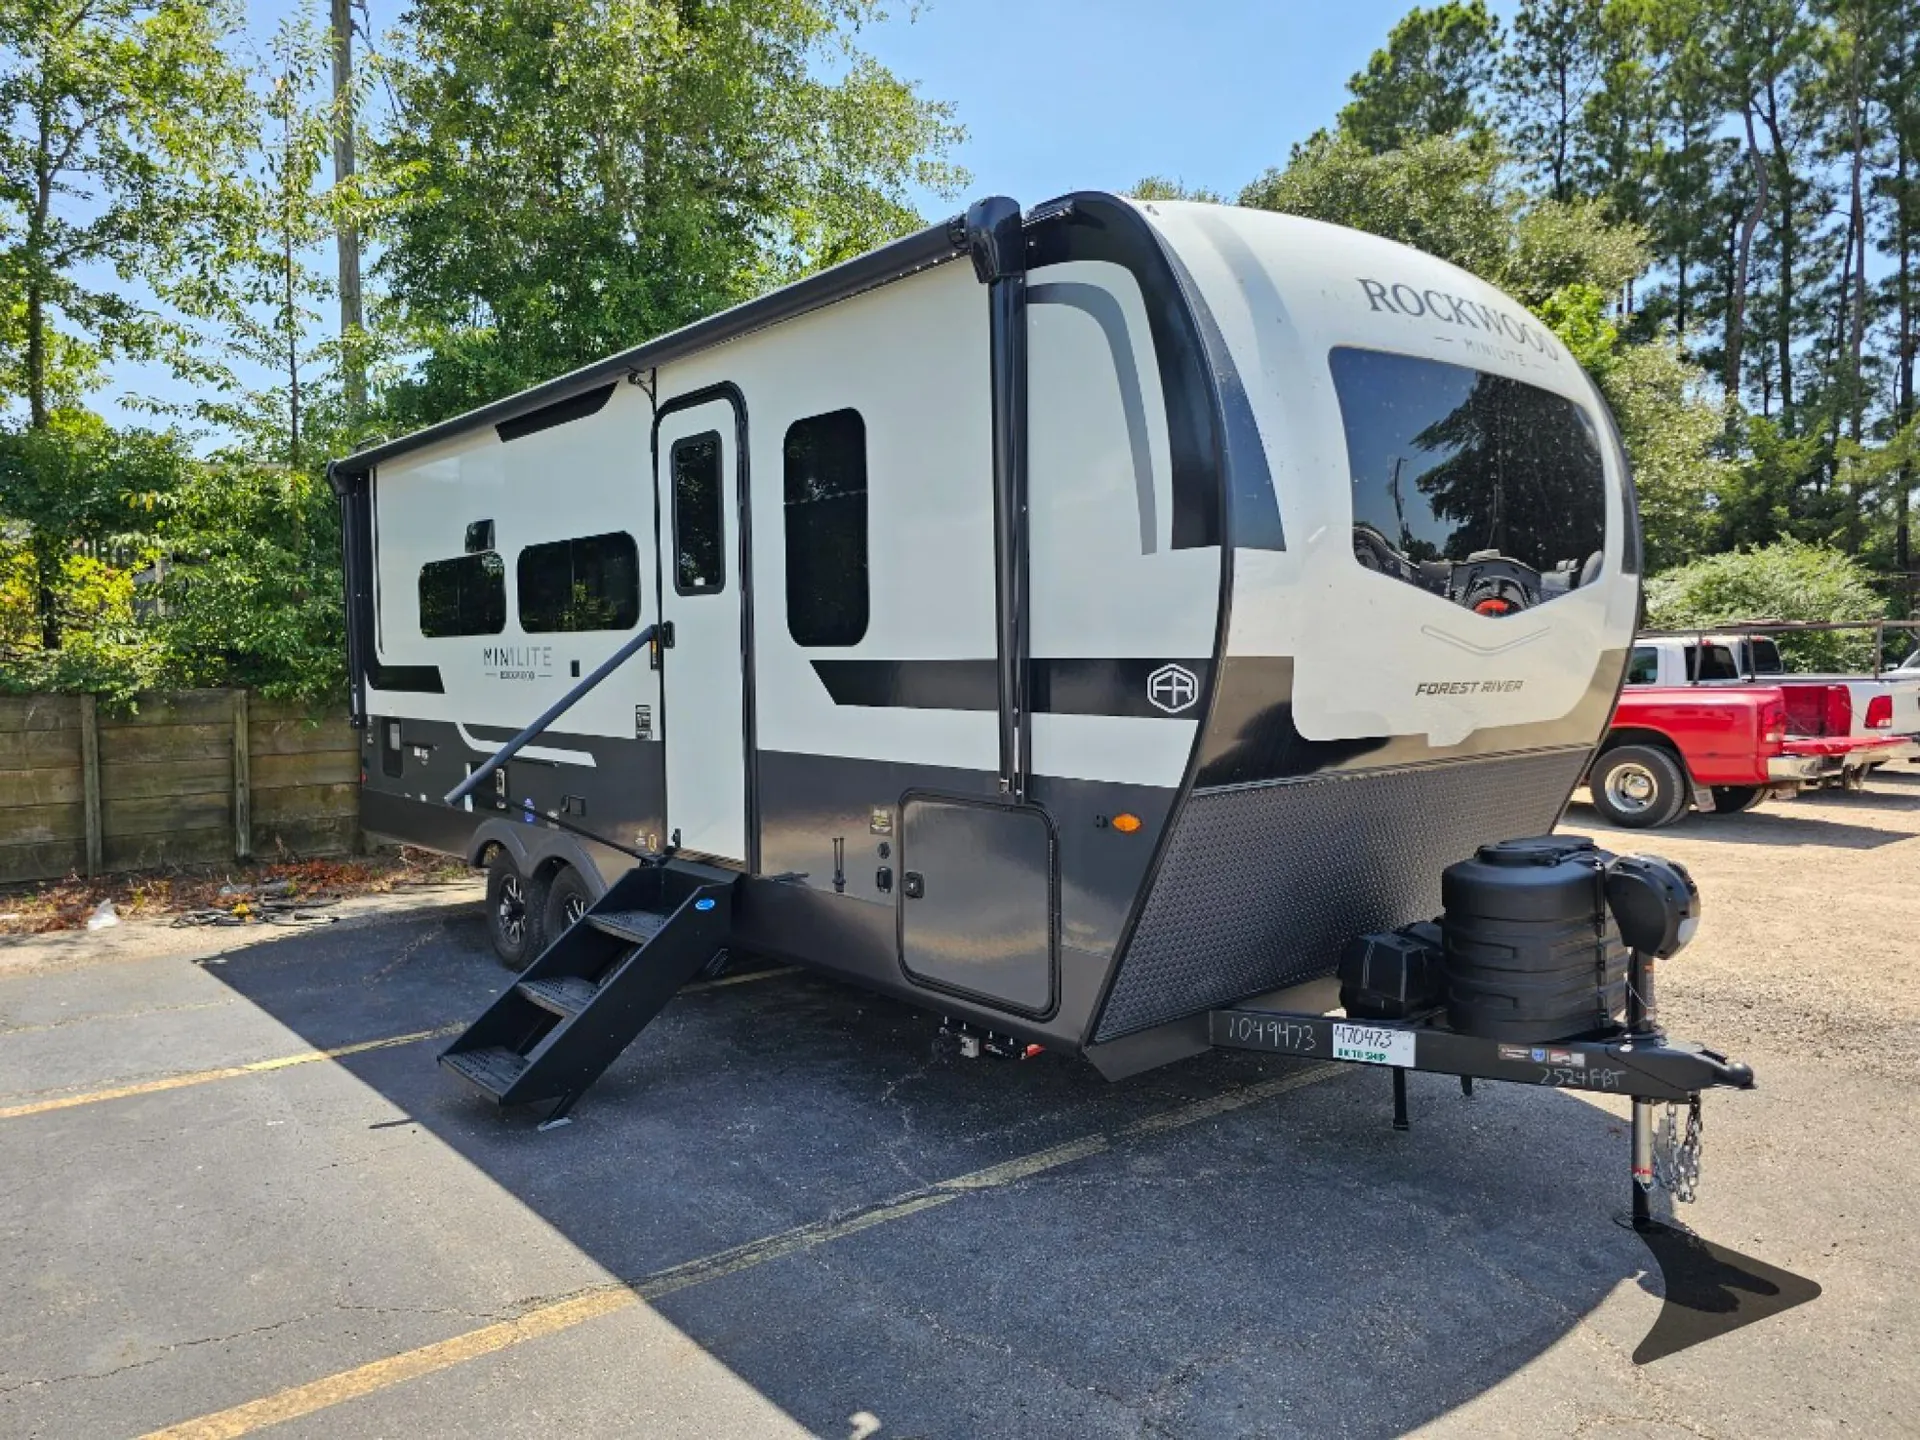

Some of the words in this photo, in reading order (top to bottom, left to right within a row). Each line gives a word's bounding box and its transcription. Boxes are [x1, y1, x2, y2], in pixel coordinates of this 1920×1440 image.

[1356, 276, 1559, 362] ROCKWOOD
[483, 645, 553, 668] MINILITE
[1415, 681, 1480, 697] FOREST
[1480, 679, 1524, 694] RIVER
[1229, 1016, 1317, 1052] 1049473
[1334, 1024, 1393, 1049] 470473
